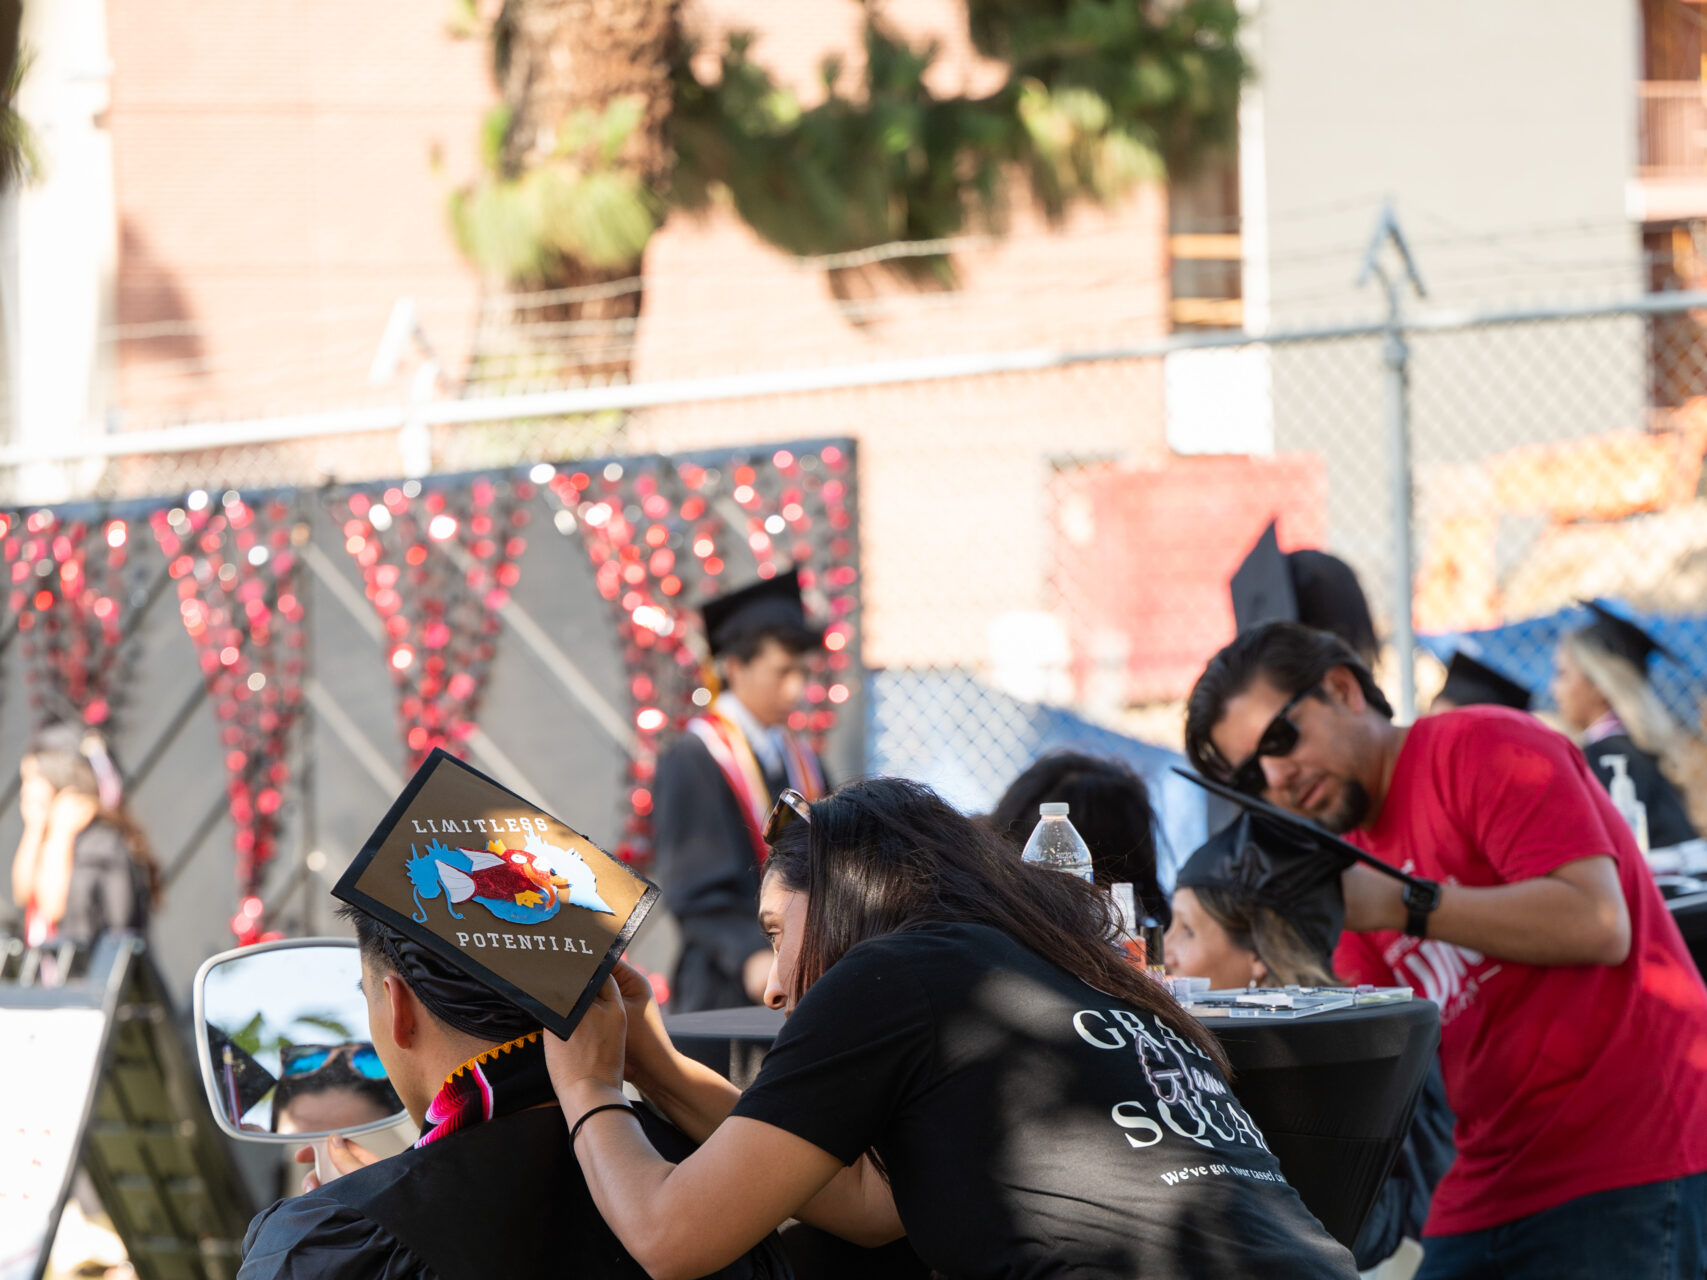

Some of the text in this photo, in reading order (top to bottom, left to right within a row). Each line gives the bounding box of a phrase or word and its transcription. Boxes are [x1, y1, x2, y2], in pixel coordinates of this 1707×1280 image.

[411, 817, 549, 834] LIMITLESS
[455, 931, 594, 956] POTENTIAL
[1072, 1009, 1212, 1061] GRA
[1160, 1166, 1209, 1187] We've
[1209, 1163, 1230, 1176] got
